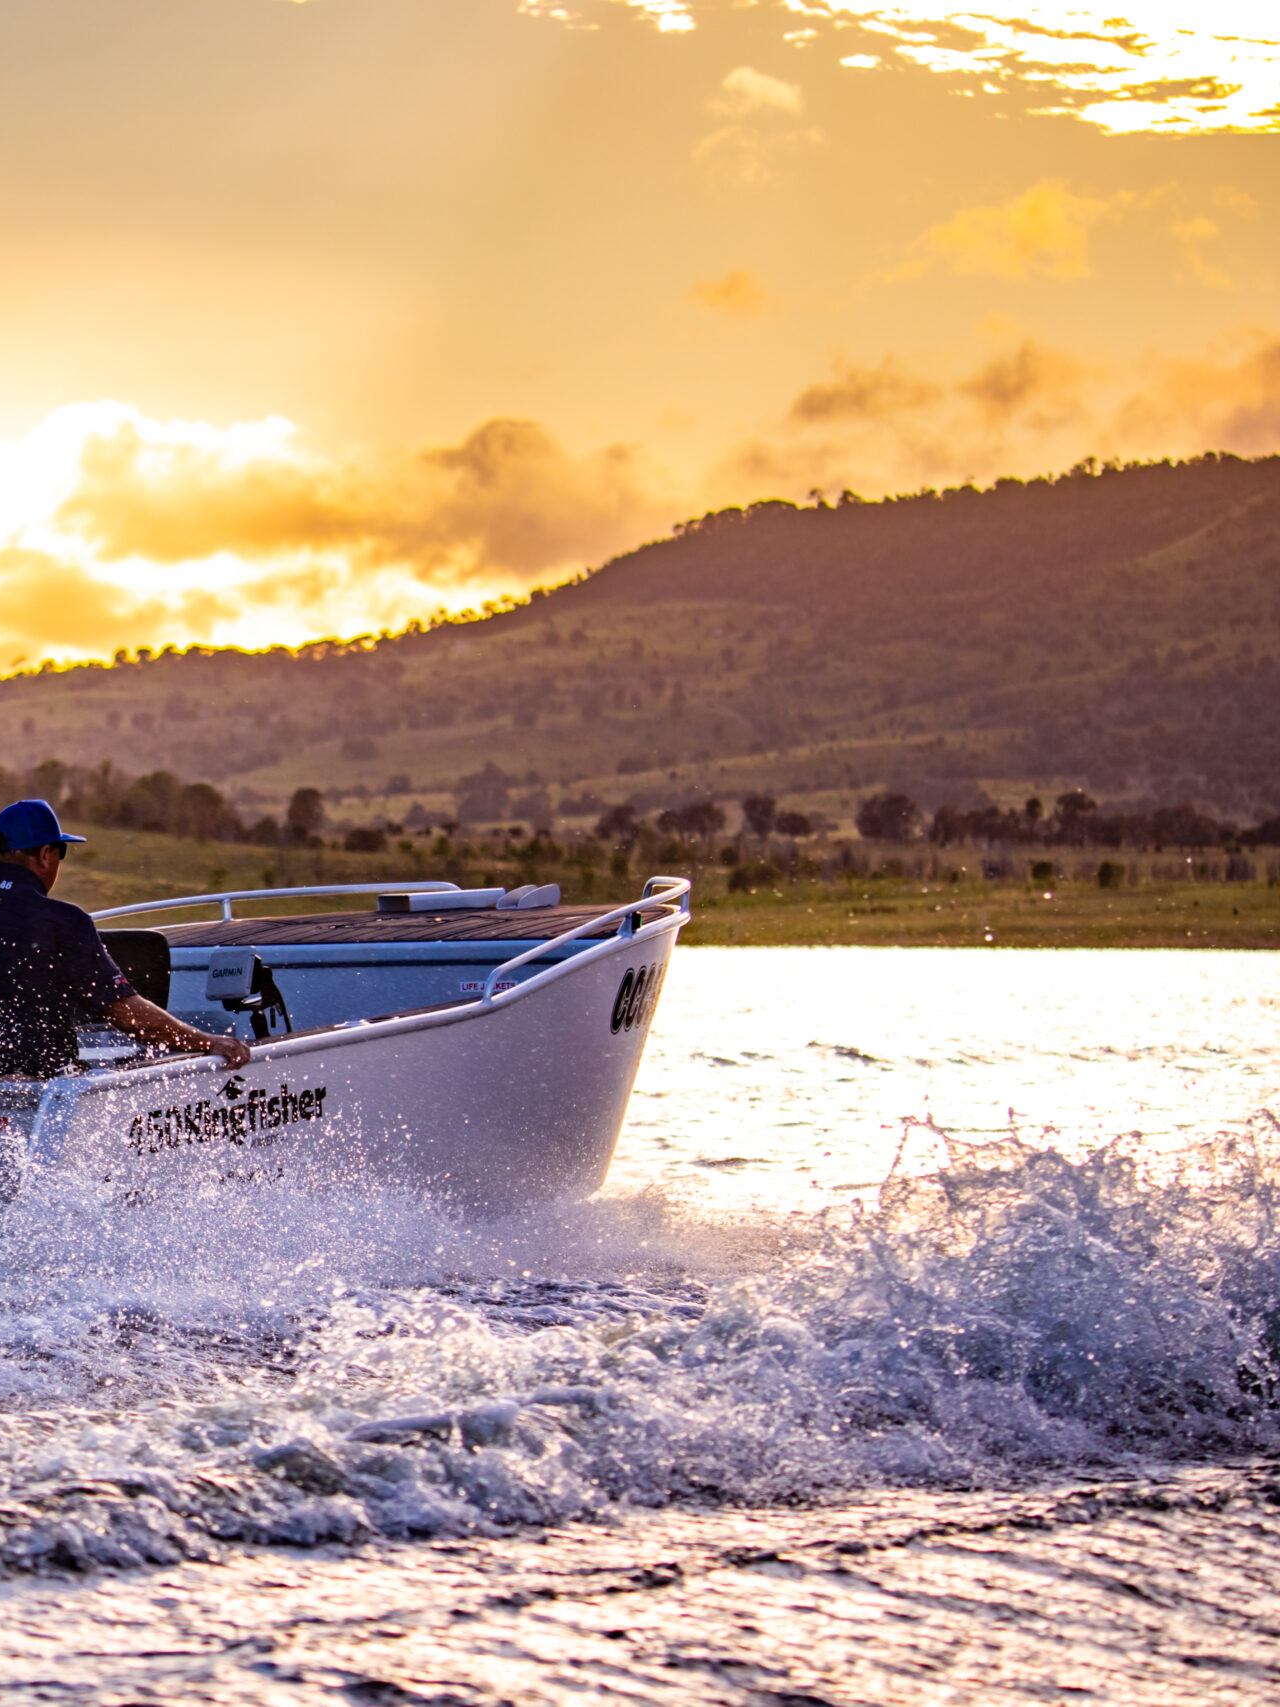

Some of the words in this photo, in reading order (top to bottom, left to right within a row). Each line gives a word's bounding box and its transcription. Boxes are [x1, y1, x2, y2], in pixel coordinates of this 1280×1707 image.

[212, 968, 243, 978] GARMIN
[462, 982, 478, 991] LIFE
[480, 982, 516, 991] JKETS
